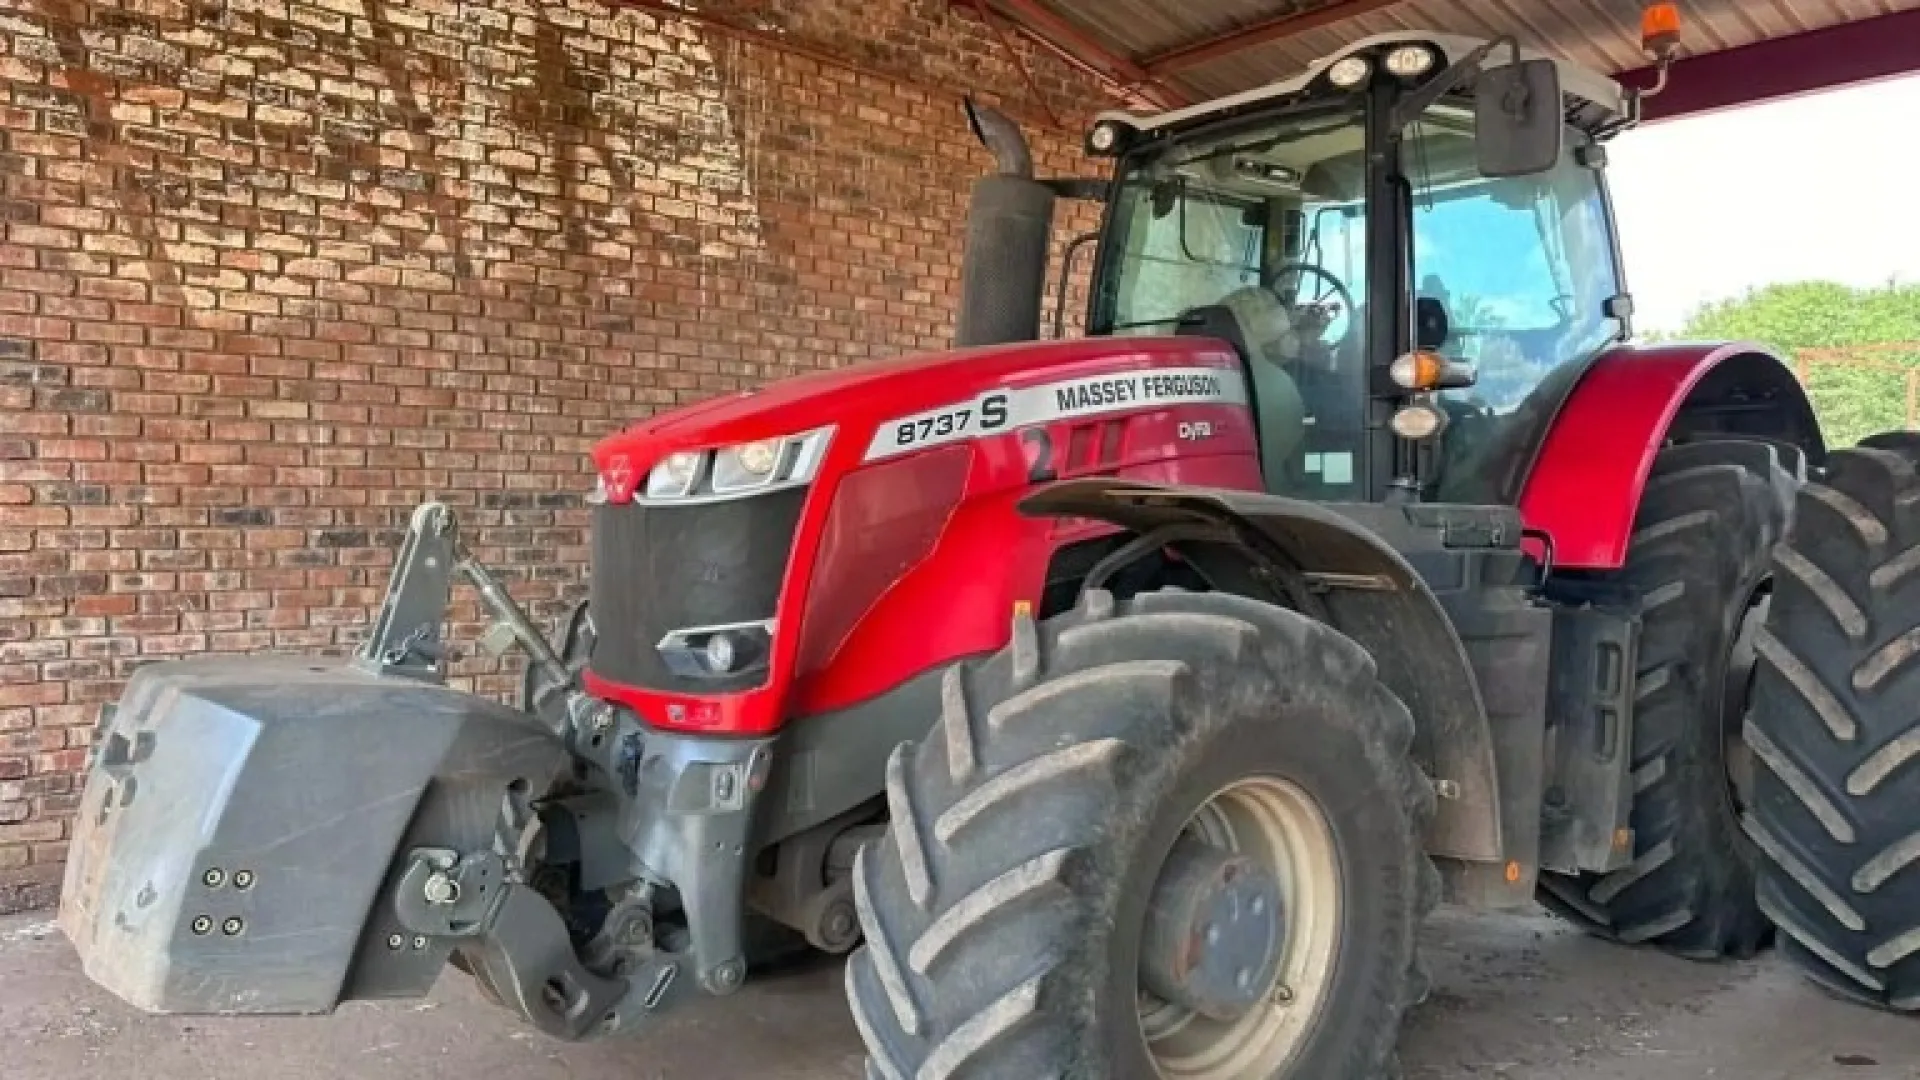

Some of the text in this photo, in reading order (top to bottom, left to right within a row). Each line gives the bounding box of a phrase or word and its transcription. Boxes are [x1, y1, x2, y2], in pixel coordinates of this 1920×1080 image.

[1055, 374, 1221, 411] MASSEY FERGUSON
[897, 394, 1009, 446] 8737 S
